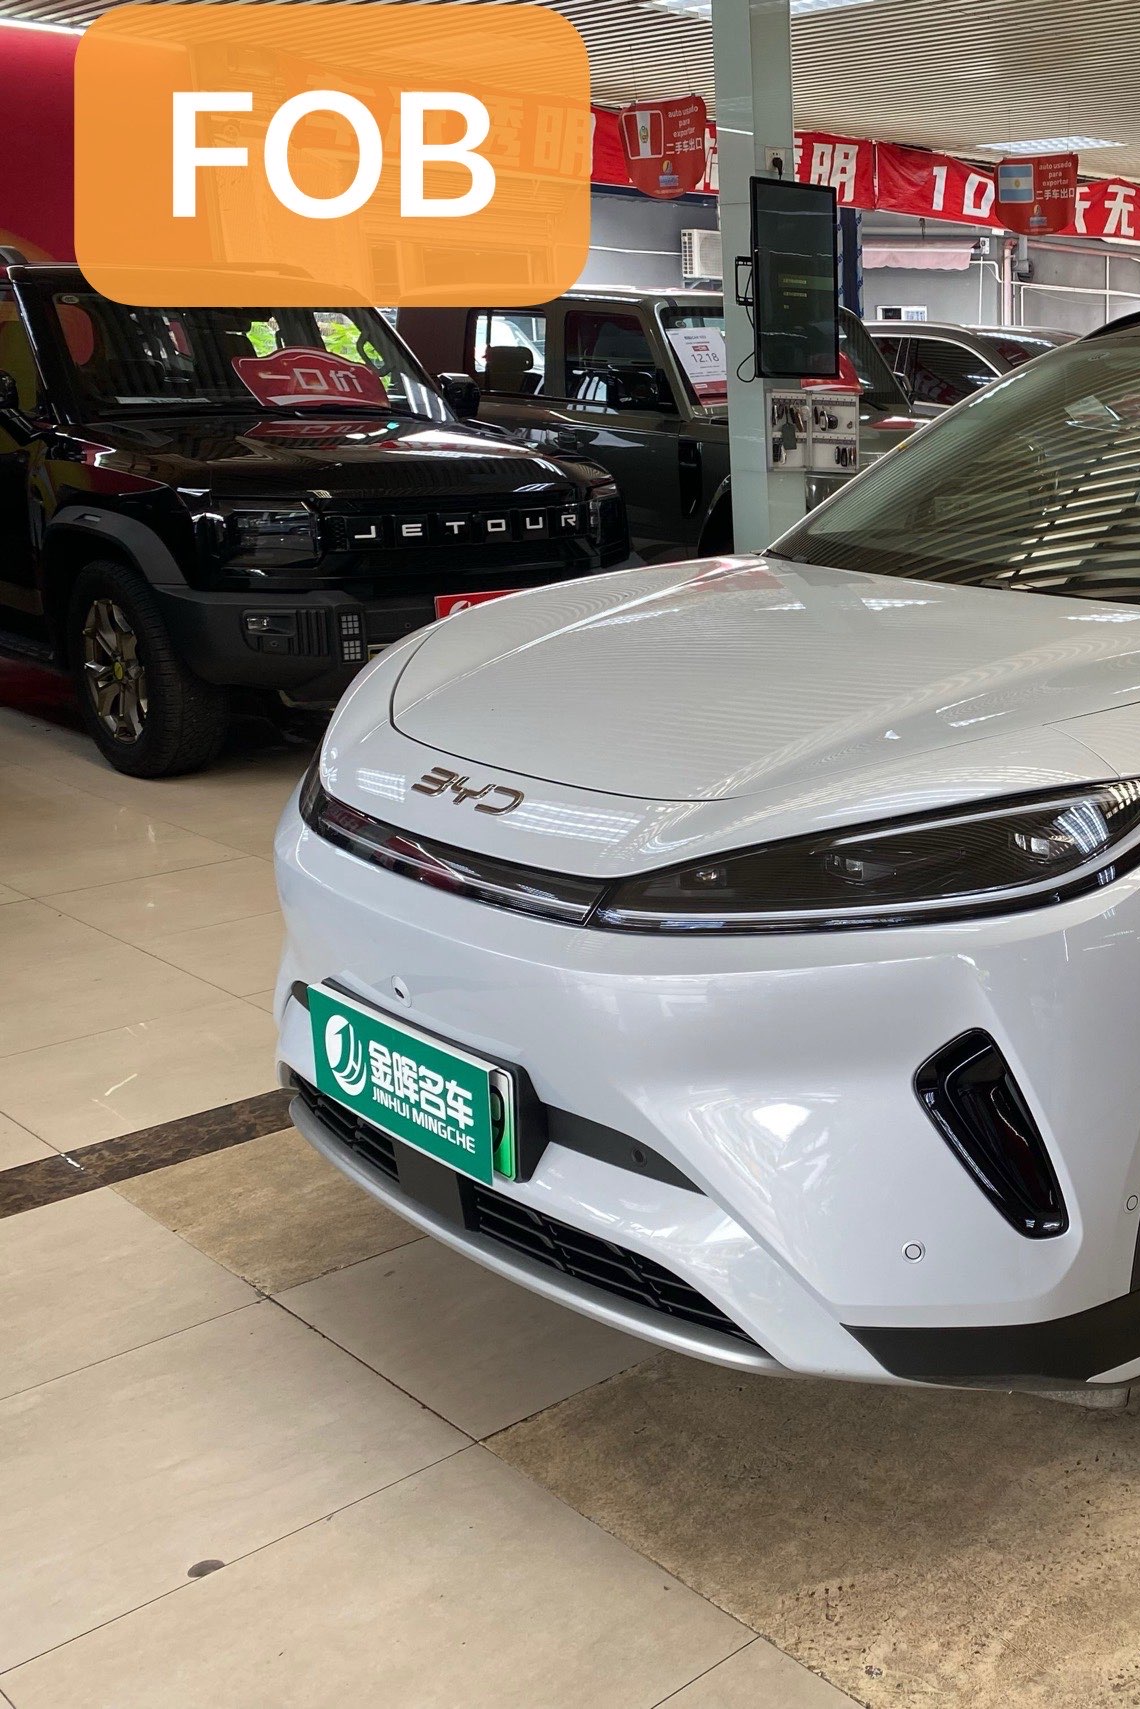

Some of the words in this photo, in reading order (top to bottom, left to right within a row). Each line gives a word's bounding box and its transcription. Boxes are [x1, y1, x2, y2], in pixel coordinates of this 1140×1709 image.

[666, 137, 703, 155] 二手车出口
[1042, 179, 1069, 187] exportar
[1048, 172, 1063, 180] para
[1035, 187, 1075, 201] 二手车出口
[691, 352, 720, 363] 12.18
[257, 366, 364, 393] 一口价
[354, 514, 577, 539] JETOUR
[411, 766, 525, 816] BYD
[368, 1039, 475, 1130] 金晖名车
[372, 1086, 410, 1119] JINHUI
[412, 1107, 476, 1154] MINGCHE
